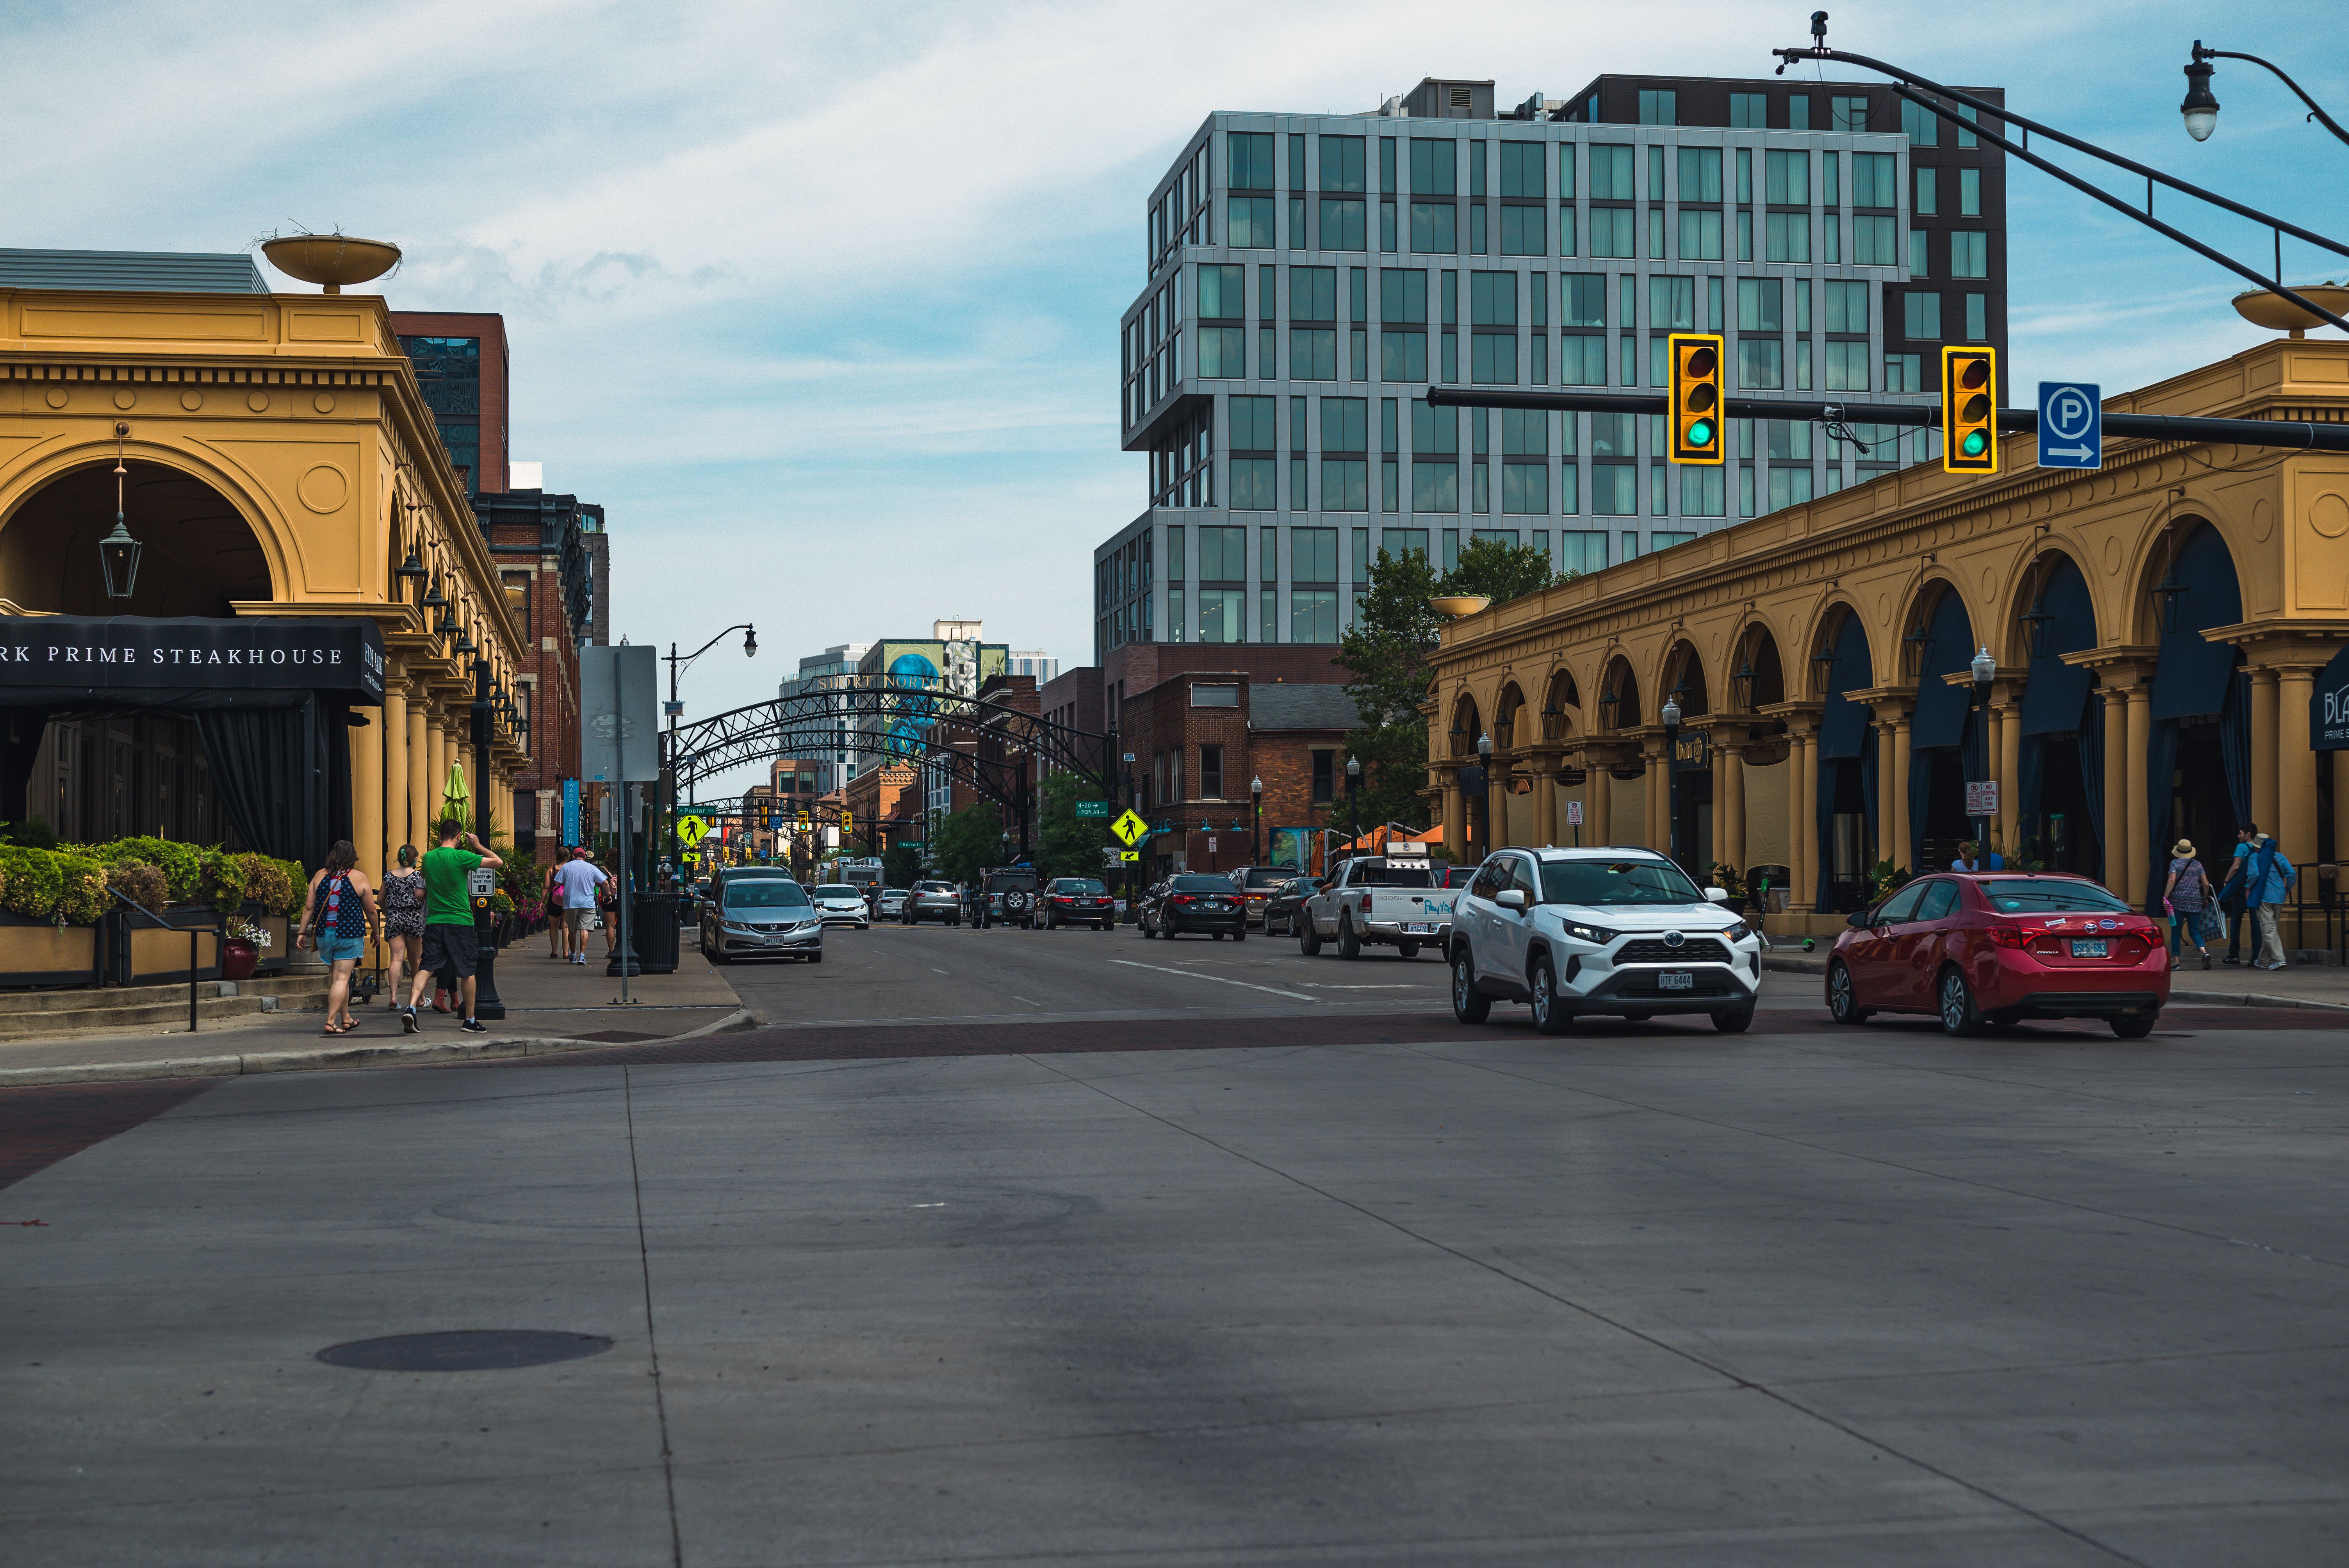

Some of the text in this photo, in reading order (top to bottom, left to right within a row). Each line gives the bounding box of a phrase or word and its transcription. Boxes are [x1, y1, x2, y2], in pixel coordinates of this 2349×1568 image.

[48, 647, 135, 663] PRIME
[153, 649, 341, 664] STEAKHOUSE
[365, 642, 382, 676] HYDE PARK
[819, 675, 939, 690] SHORT NORTH
[2325, 729, 2345, 740] PRIME
[1676, 740, 1701, 760] bar 23
[1660, 975, 1691, 985] HTF 6444
